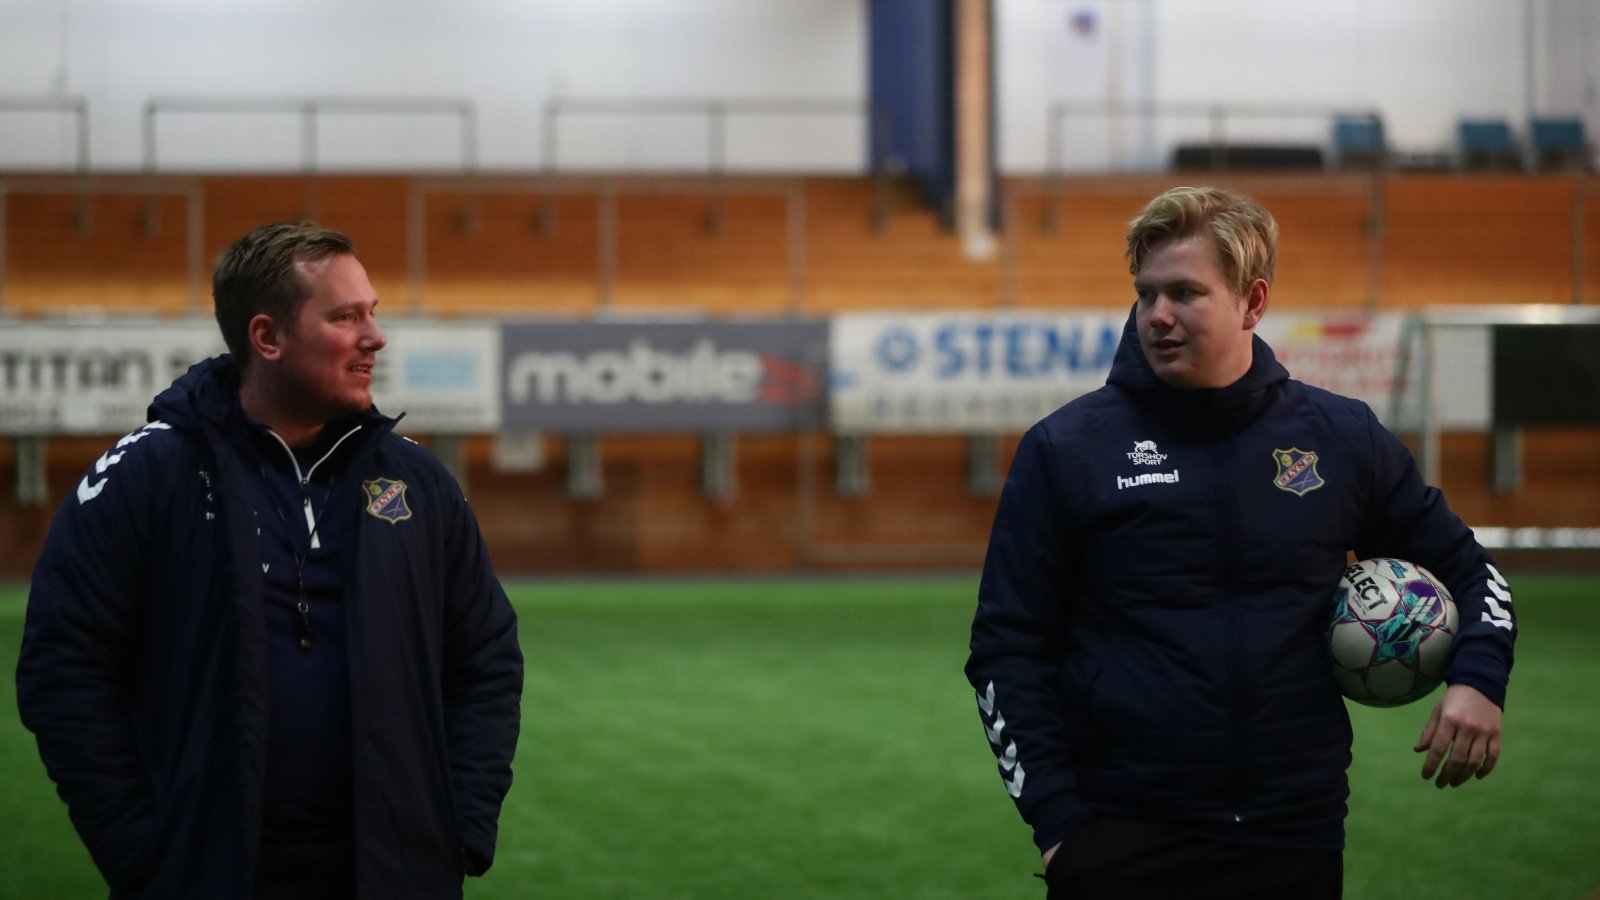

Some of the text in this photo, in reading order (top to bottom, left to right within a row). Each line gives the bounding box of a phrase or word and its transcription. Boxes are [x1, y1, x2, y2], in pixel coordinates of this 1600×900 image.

[1126, 452, 1168, 461] TORSHOV
[1117, 469, 1180, 490] hummel
[1342, 563, 1386, 610] ELECT
